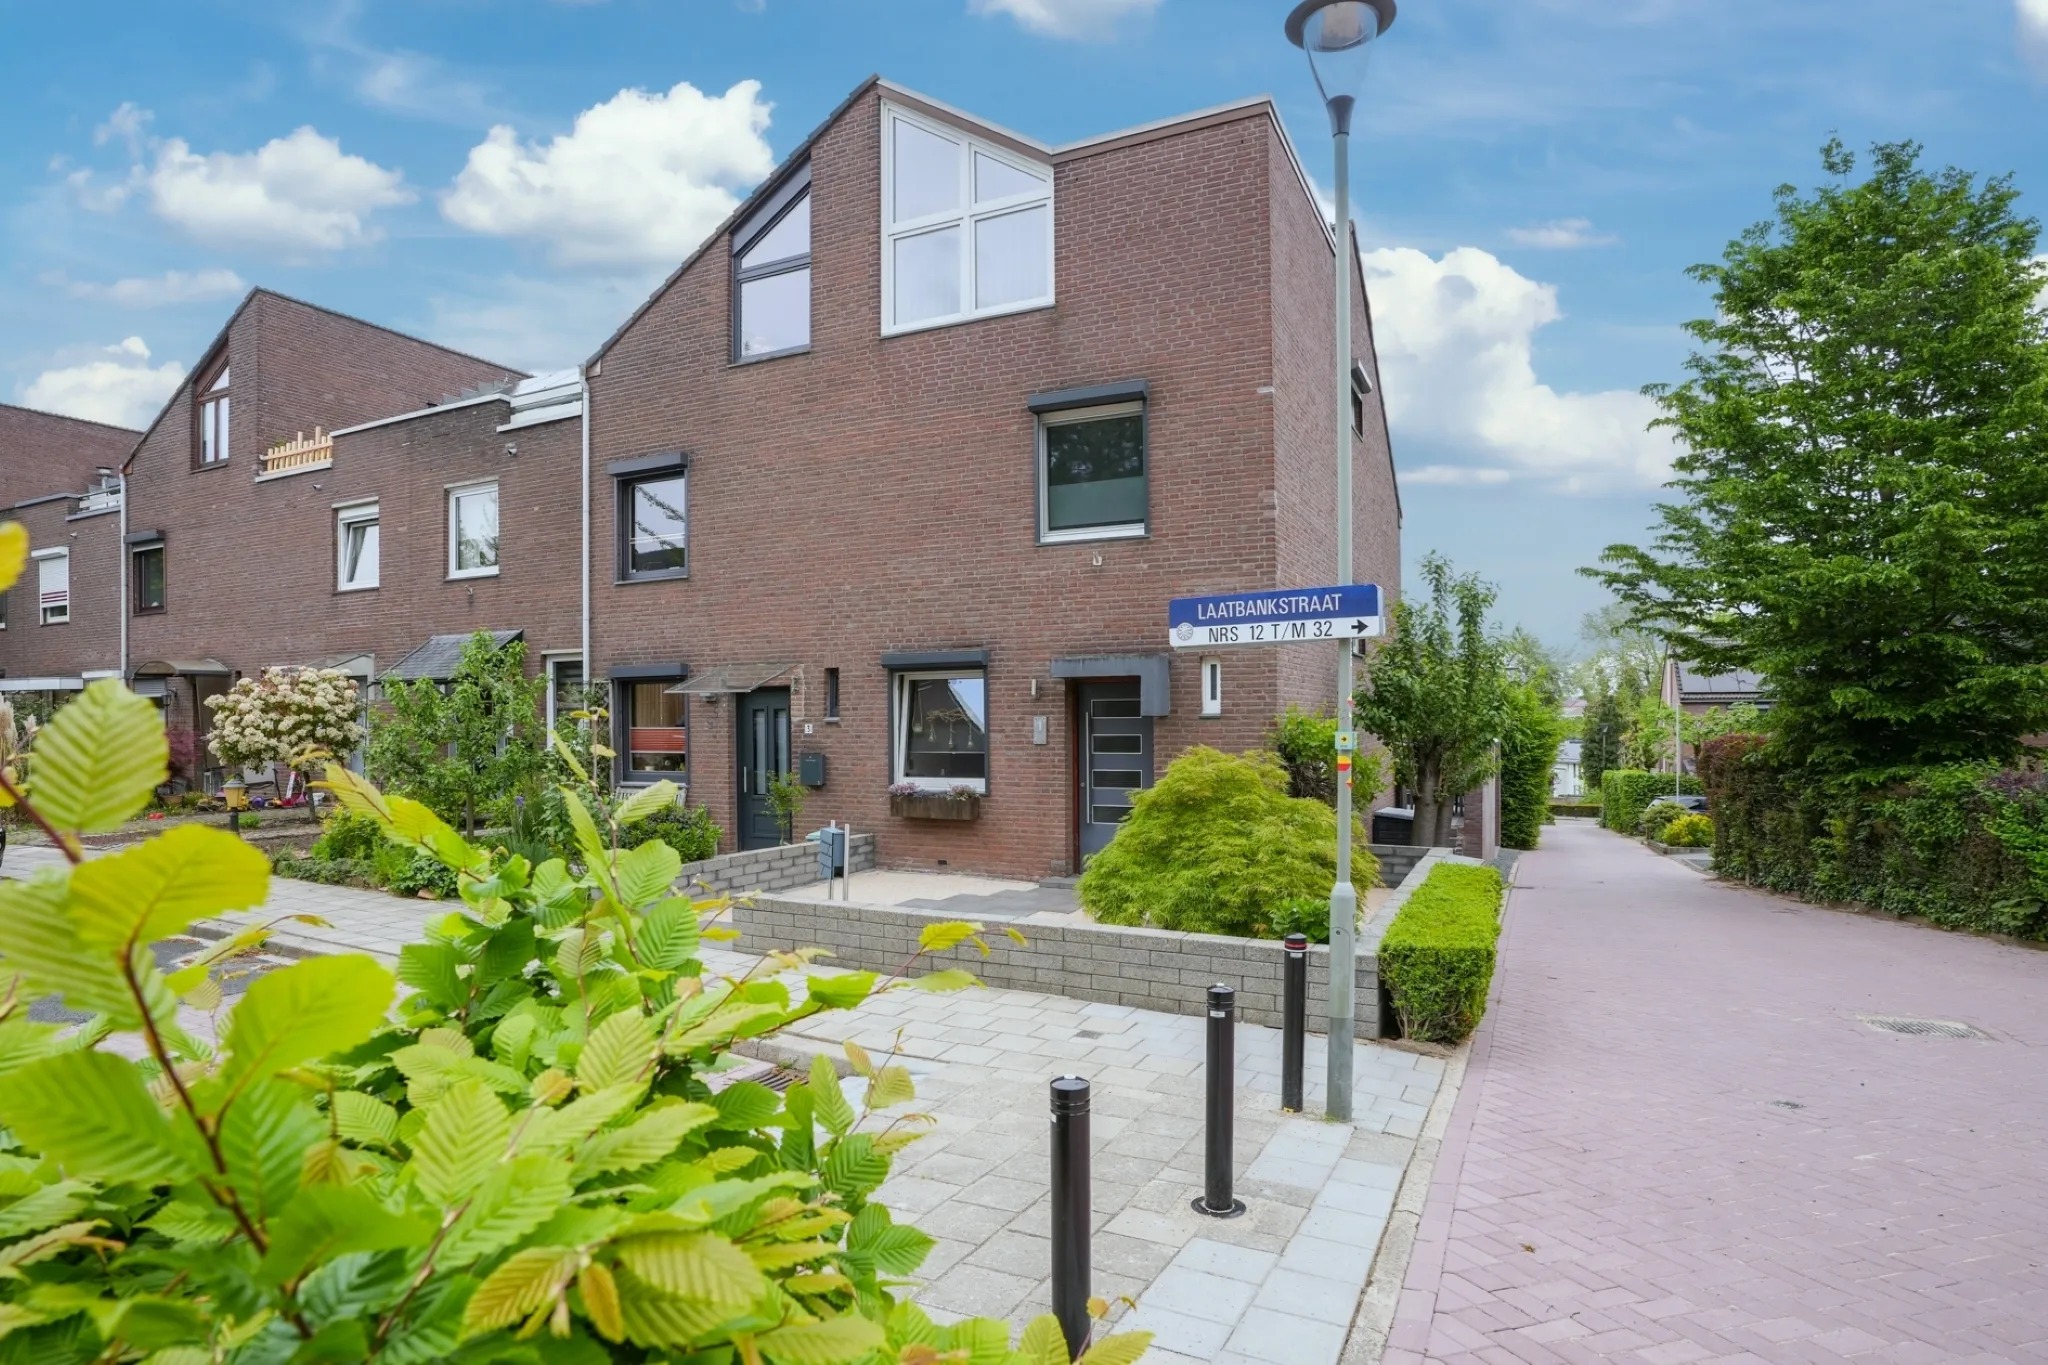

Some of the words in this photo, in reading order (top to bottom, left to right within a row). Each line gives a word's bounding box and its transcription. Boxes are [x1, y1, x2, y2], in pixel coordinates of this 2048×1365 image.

[1198, 594, 1342, 620] LAATBANKSTRAAT
[1208, 626, 1239, 643] NRS
[1250, 625, 1264, 641] 12
[1313, 620, 1333, 638] 32
